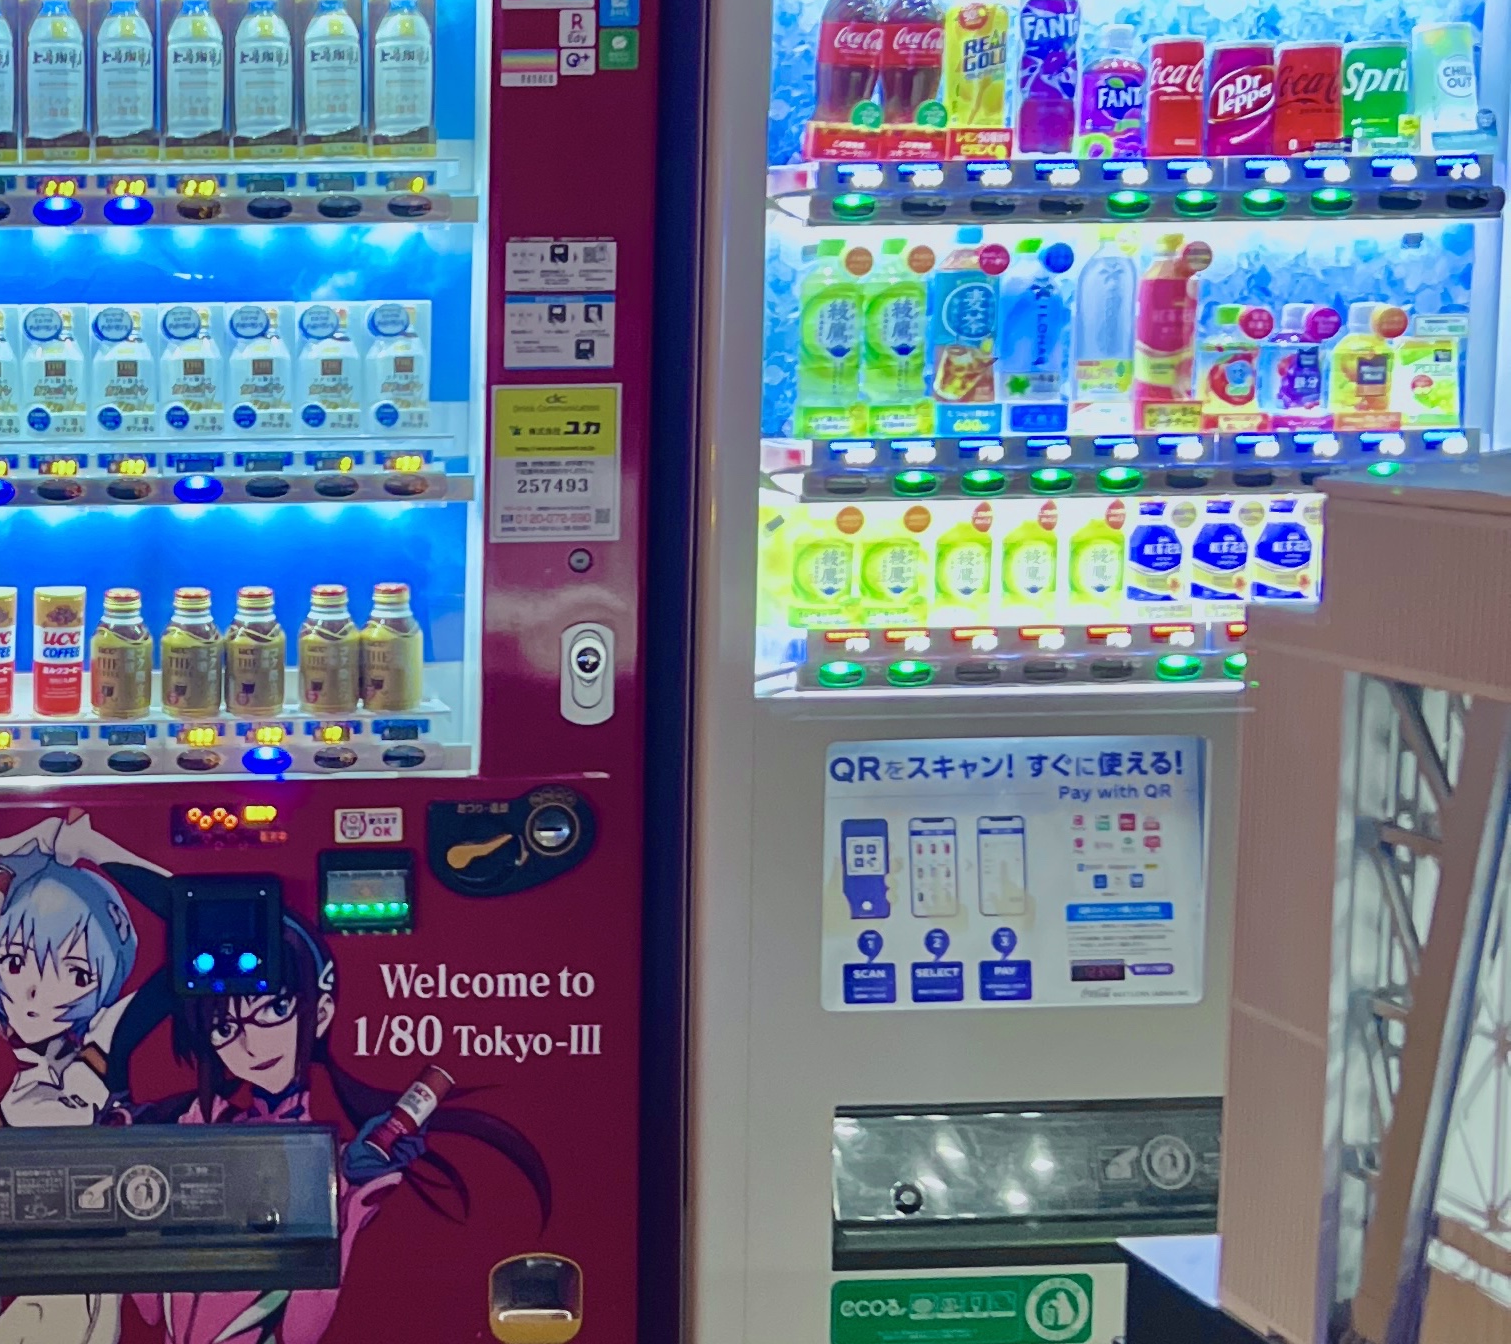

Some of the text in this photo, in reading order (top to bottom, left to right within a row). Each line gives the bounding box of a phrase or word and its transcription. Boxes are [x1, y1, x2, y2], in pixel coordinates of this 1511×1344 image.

[1234, 74, 1263, 94] Dr
[961, 288, 985, 334] 麦茶
[517, 478, 589, 493] 257493
[43, 631, 81, 646] UCC
[42, 647, 80, 659] COFFEE
[1058, 784, 1172, 802] Pay with QR
[373, 826, 392, 836] OK
[933, 938, 942, 947] 2
[1001, 937, 1010, 946] 3
[852, 969, 886, 978] SCAN
[915, 968, 959, 977] SELECT
[994, 967, 1016, 975] PAY
[379, 963, 595, 999] Welcome to
[354, 1014, 602, 1063] 1/80 Tokyo-III
